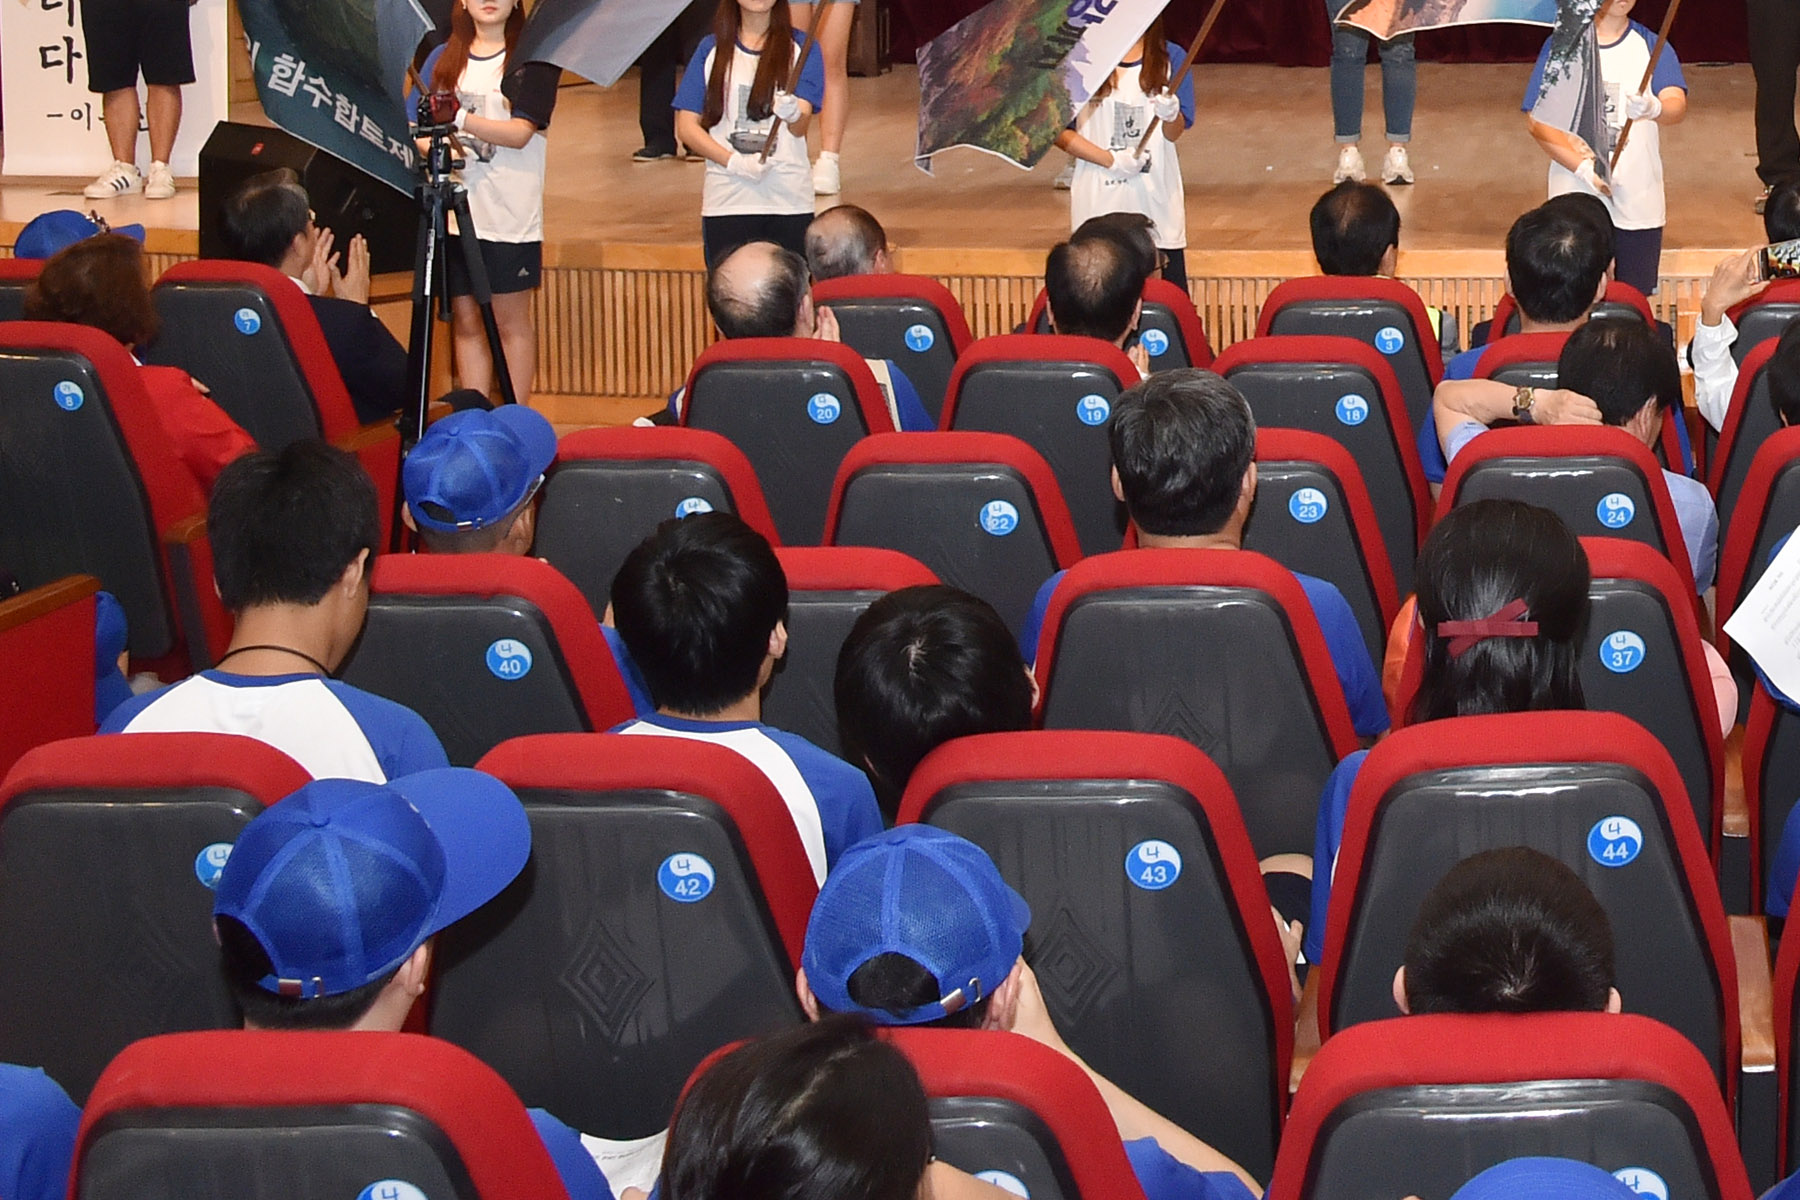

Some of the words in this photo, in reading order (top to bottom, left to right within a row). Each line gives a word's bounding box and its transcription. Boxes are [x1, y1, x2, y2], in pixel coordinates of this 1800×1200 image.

[817, 409, 833, 418] 20
[1086, 411, 1101, 421] 19
[1346, 411, 1360, 420] 18
[1300, 506, 1317, 517] 23
[1607, 511, 1625, 522] 24
[990, 517, 1008, 529] 22
[1612, 652, 1633, 665] 37
[499, 660, 520, 673] 40
[1603, 843, 1628, 859] 44
[1142, 867, 1166, 882] 43
[675, 880, 701, 895] 42
